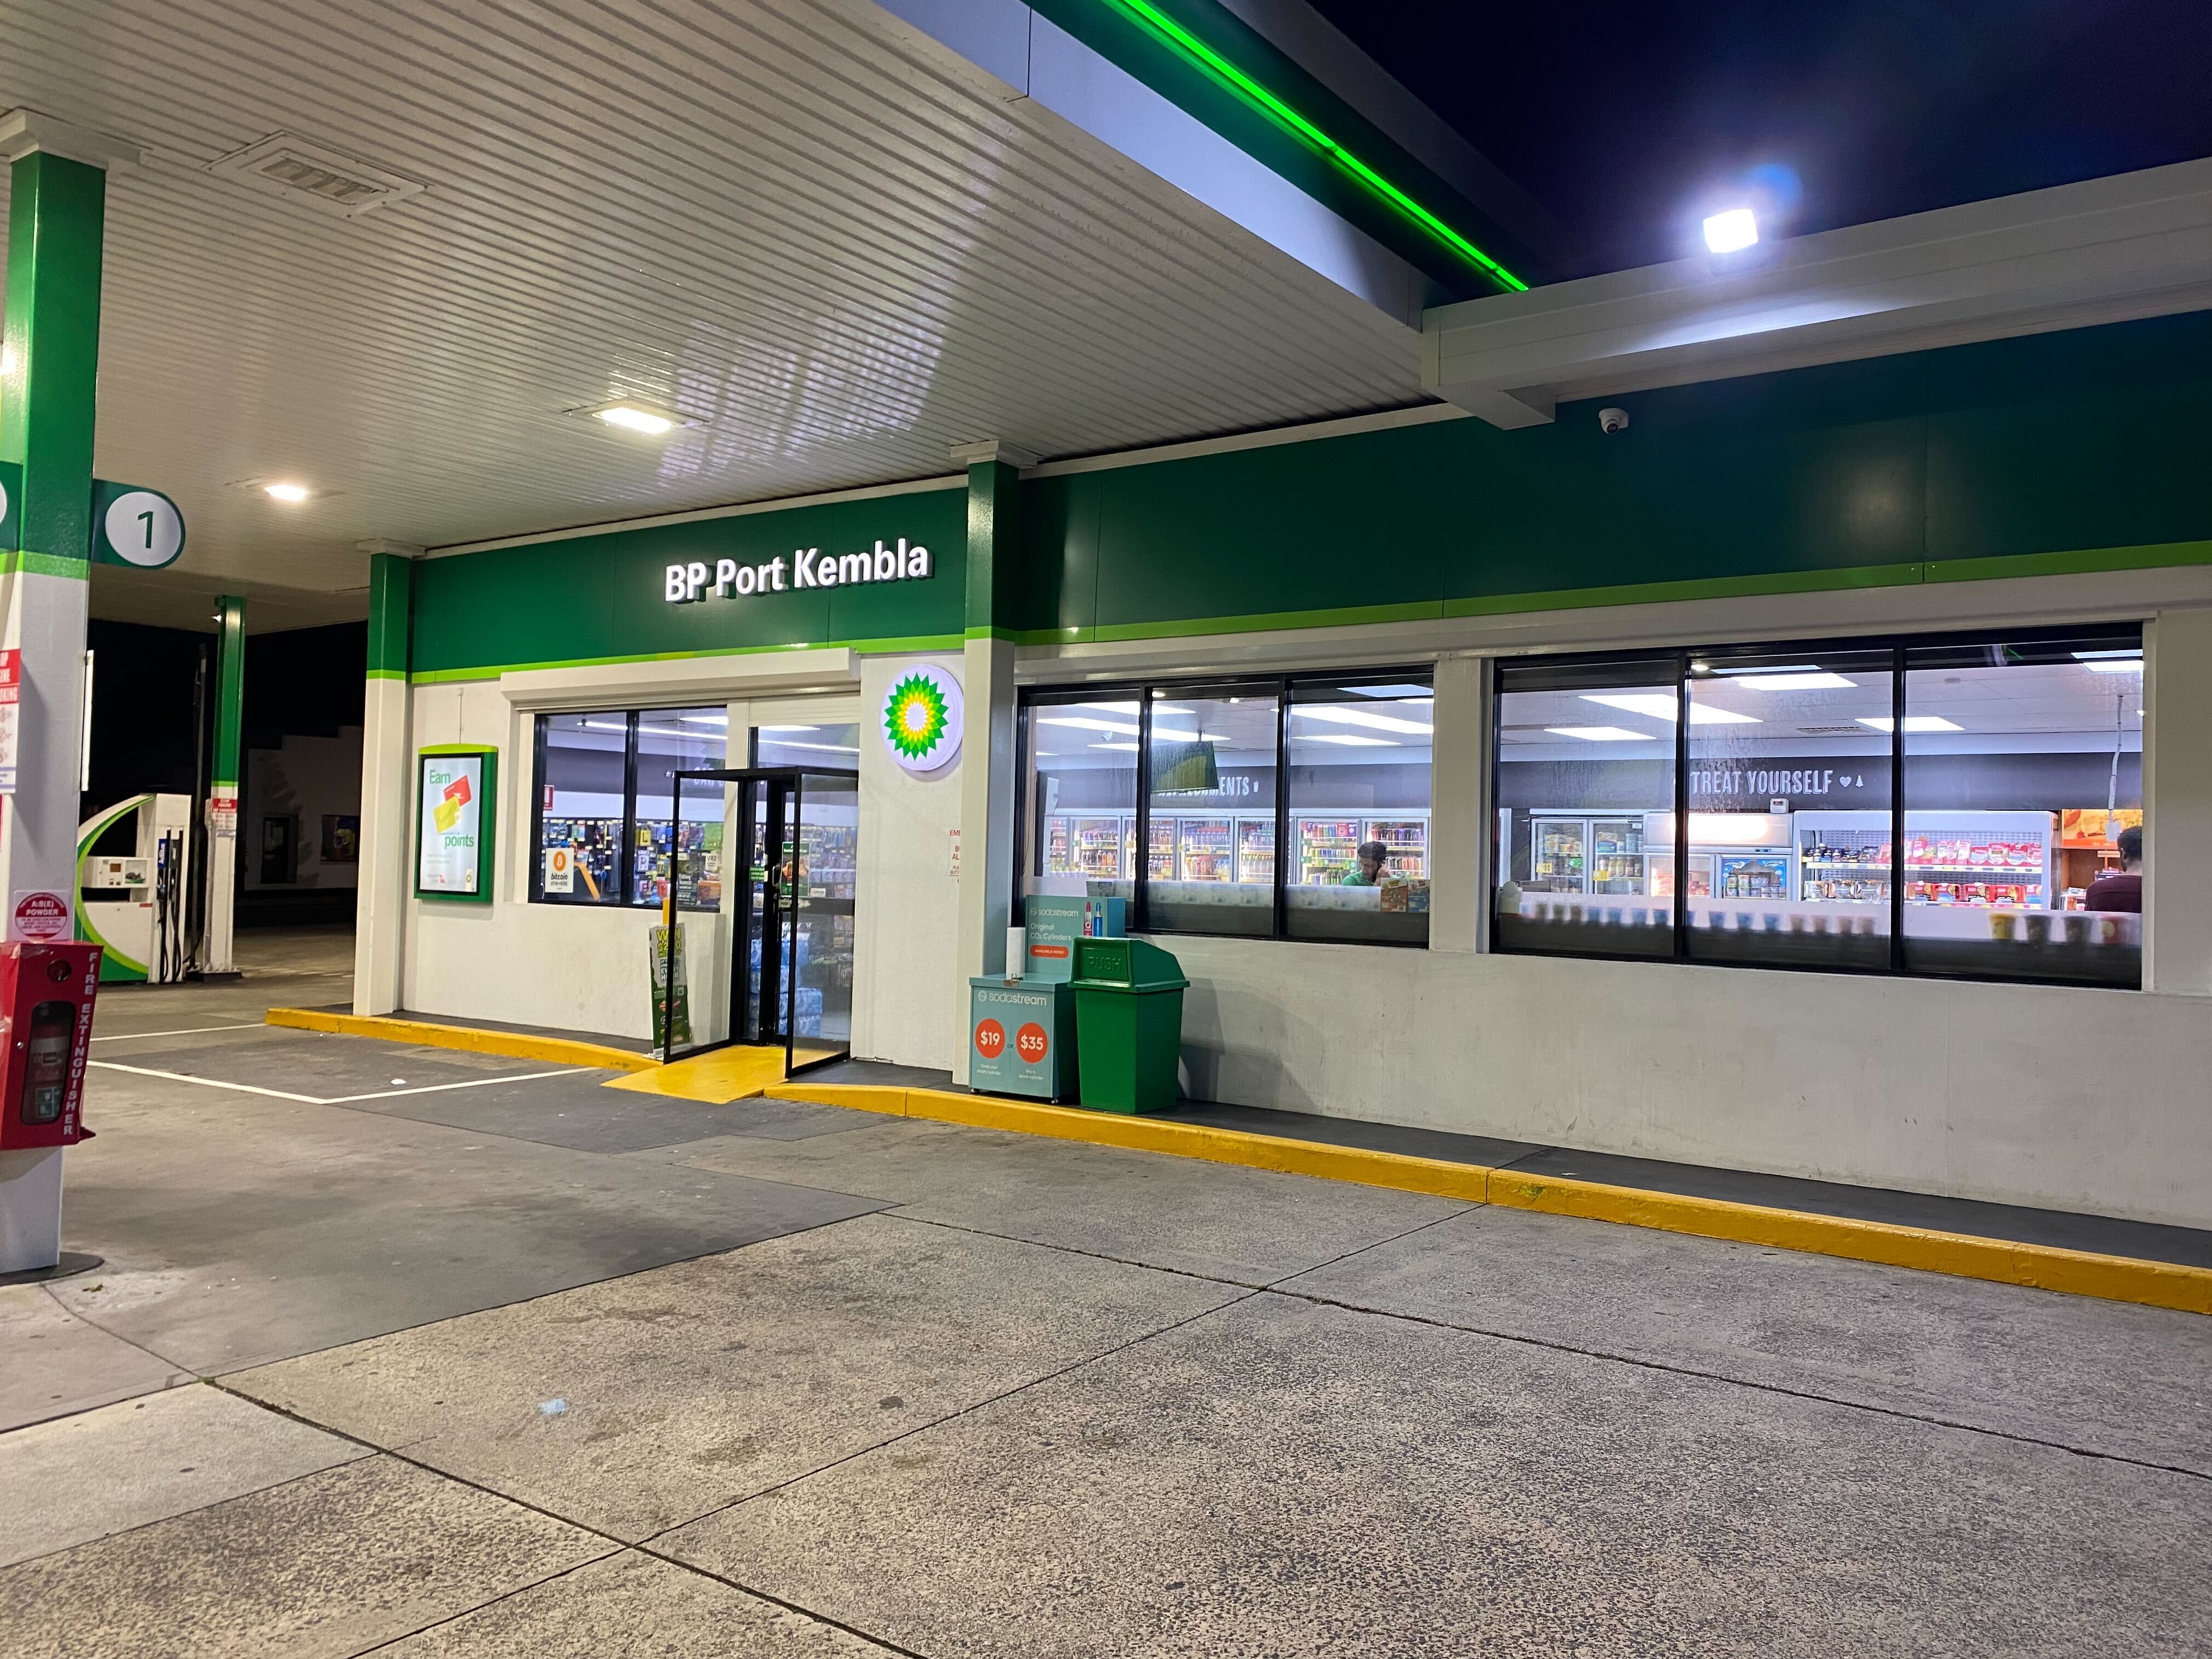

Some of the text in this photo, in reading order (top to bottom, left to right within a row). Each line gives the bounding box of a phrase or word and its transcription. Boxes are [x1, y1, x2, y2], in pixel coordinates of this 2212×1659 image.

[138, 511, 154, 549] 1
[665, 538, 929, 602] BP Port Kembla
[429, 770, 451, 784] Earn
[1690, 770, 1833, 794] TREAT YOURSELF
[444, 832, 475, 850] points
[550, 872, 568, 881] bitcoin
[1037, 909, 1079, 917] sodastream
[1030, 923, 1054, 932] Original
[1043, 933, 1072, 941] Cylinders
[1088, 956, 1122, 971] PUSH
[989, 992, 1047, 1006] sodastream
[63, 952, 98, 1136] FIRE EXTINGUISHER
[980, 1029, 1001, 1046] $19
[1020, 1034, 1044, 1051] $35
